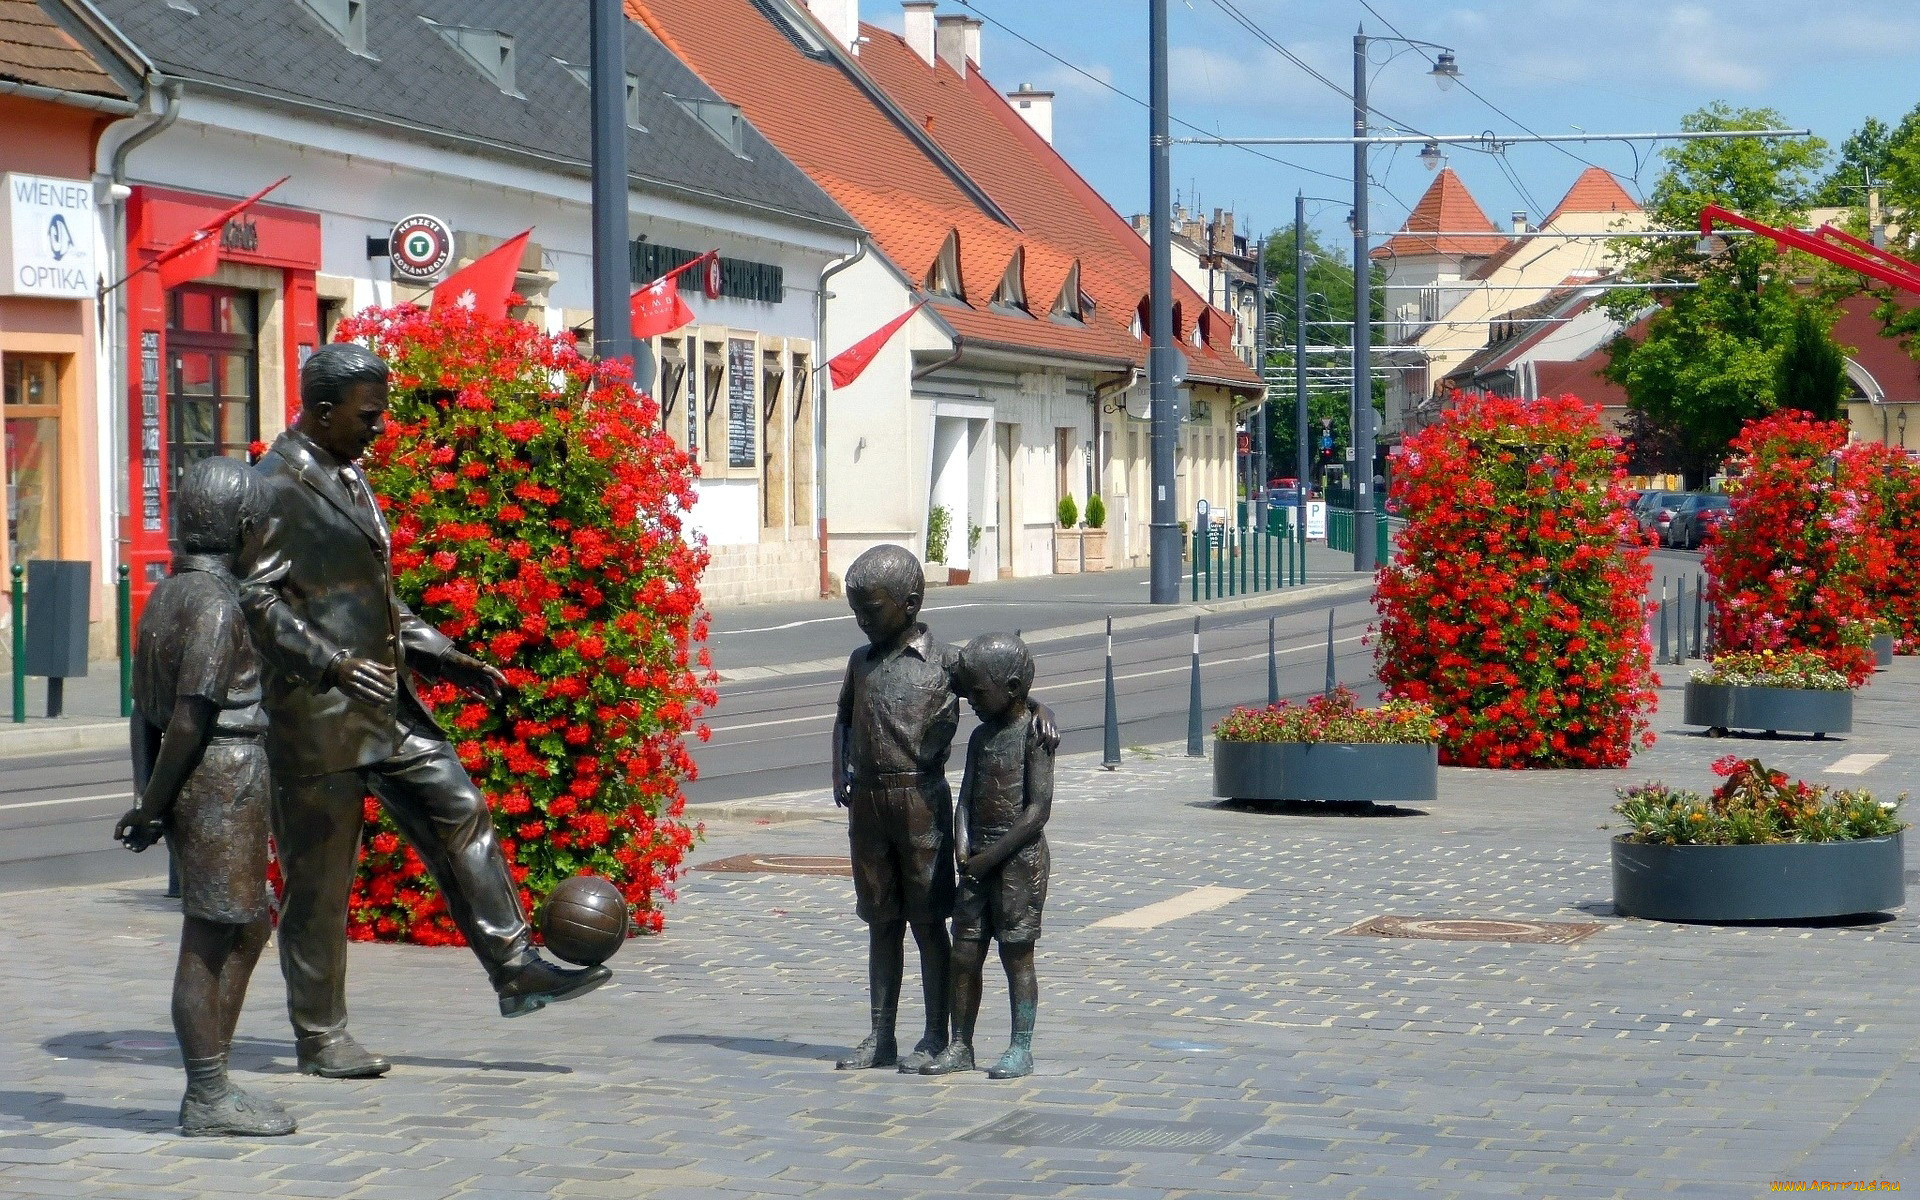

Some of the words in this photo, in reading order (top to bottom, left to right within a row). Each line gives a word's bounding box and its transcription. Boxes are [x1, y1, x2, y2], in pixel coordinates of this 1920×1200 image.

[14, 180, 88, 209] WIENER
[399, 219, 440, 233] NEMZETI
[413, 241, 426, 253] T
[20, 265, 88, 290] OPTIKA
[1312, 504, 1320, 518] P
